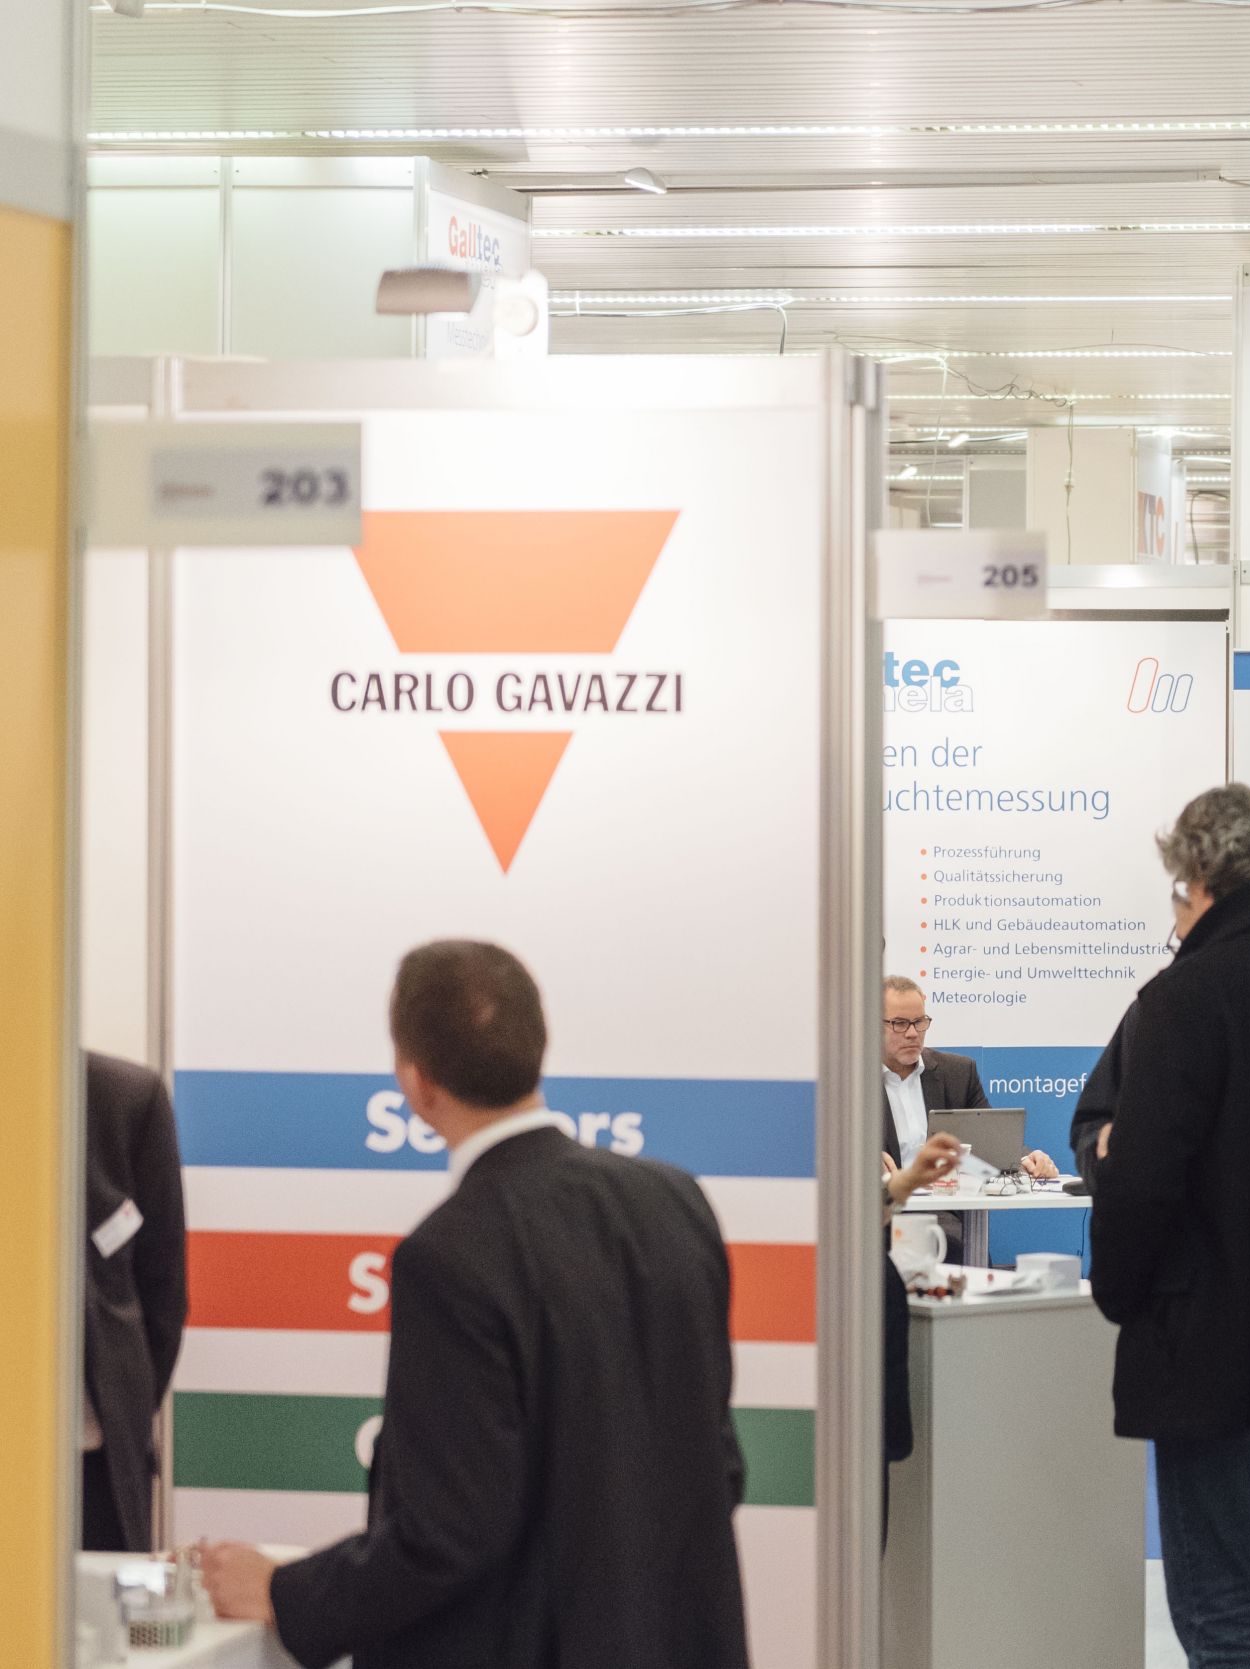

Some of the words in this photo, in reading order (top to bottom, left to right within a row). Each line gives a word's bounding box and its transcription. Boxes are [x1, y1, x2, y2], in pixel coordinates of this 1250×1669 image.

[448, 215, 500, 265] Galltec
[260, 465, 351, 507] 203
[981, 563, 1040, 588] 205
[331, 672, 475, 713] CARLO
[496, 672, 683, 713] GAVAZZI
[931, 737, 983, 767] der
[933, 846, 1041, 862] Prozessführung
[933, 870, 1063, 886] Qualitätssicherung
[934, 895, 1101, 908] Produktionsautomation
[934, 919, 961, 931] HLK
[966, 919, 992, 931] und
[997, 919, 1146, 931] Gebäudeautomation
[933, 943, 977, 959] Agrar-
[983, 942, 1010, 956] und
[1015, 942, 1170, 956] Lebensmittelindustrie
[933, 967, 991, 984] Energie-
[995, 966, 1022, 980] und
[1027, 966, 1136, 980] Umwelttechnik
[932, 991, 1027, 1008] Meteorologie
[990, 1073, 1087, 1097] montagef
[365, 1090, 644, 1157] Sers
